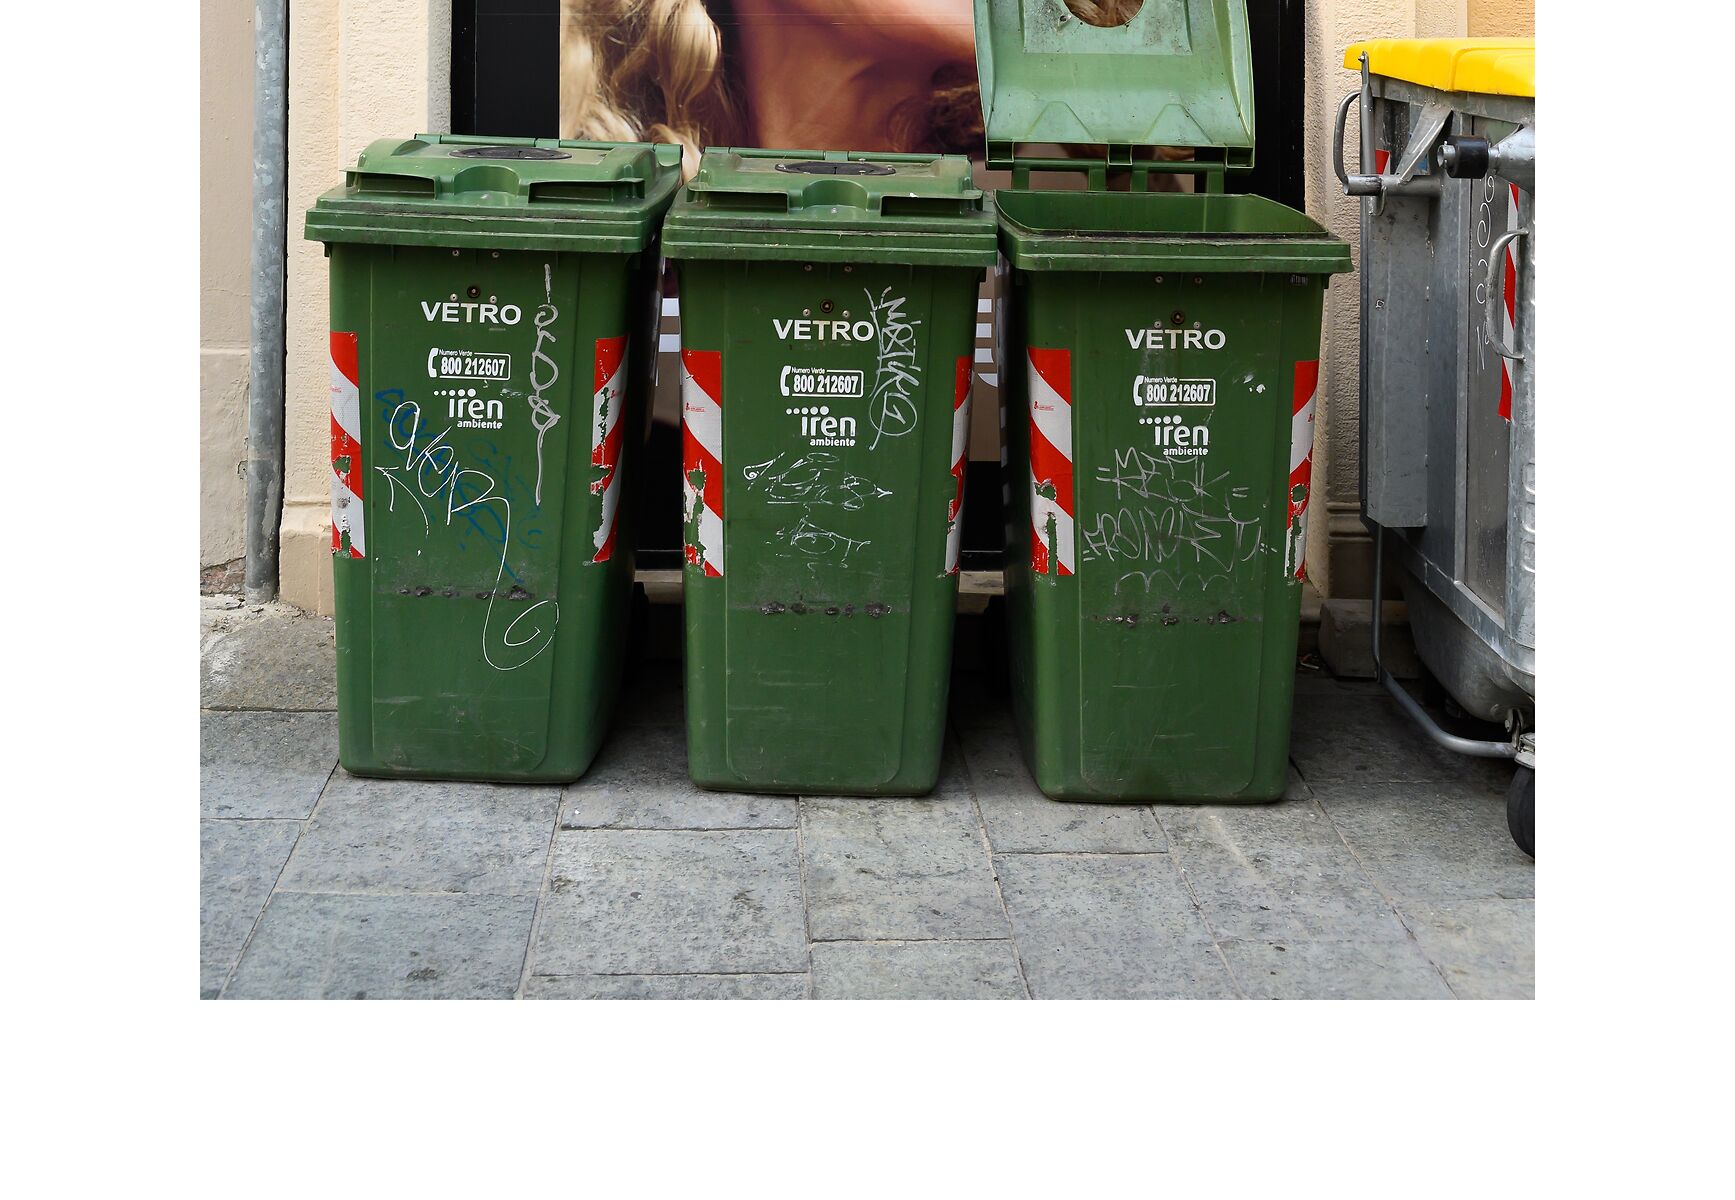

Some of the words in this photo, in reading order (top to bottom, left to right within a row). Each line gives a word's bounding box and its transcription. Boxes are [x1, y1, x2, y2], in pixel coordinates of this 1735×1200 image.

[421, 301, 522, 326] VETRO
[772, 318, 875, 342] VETRO
[1124, 328, 1227, 350] VETRO
[439, 348, 459, 356] Numero
[441, 356, 462, 375] 800
[464, 357, 506, 377] 212607
[791, 366, 811, 374] Numero
[793, 374, 815, 393] 800
[817, 374, 859, 394] 212607
[1143, 376, 1164, 384] Numero
[1146, 383, 1168, 402] 800
[1169, 383, 1211, 402] 212607
[448, 390, 504, 420] iren
[456, 419, 503, 429] ambiente
[801, 407, 857, 437] iren
[1154, 416, 1209, 446] iren
[809, 437, 856, 447] ambiente
[1162, 446, 1209, 456] ambiente
